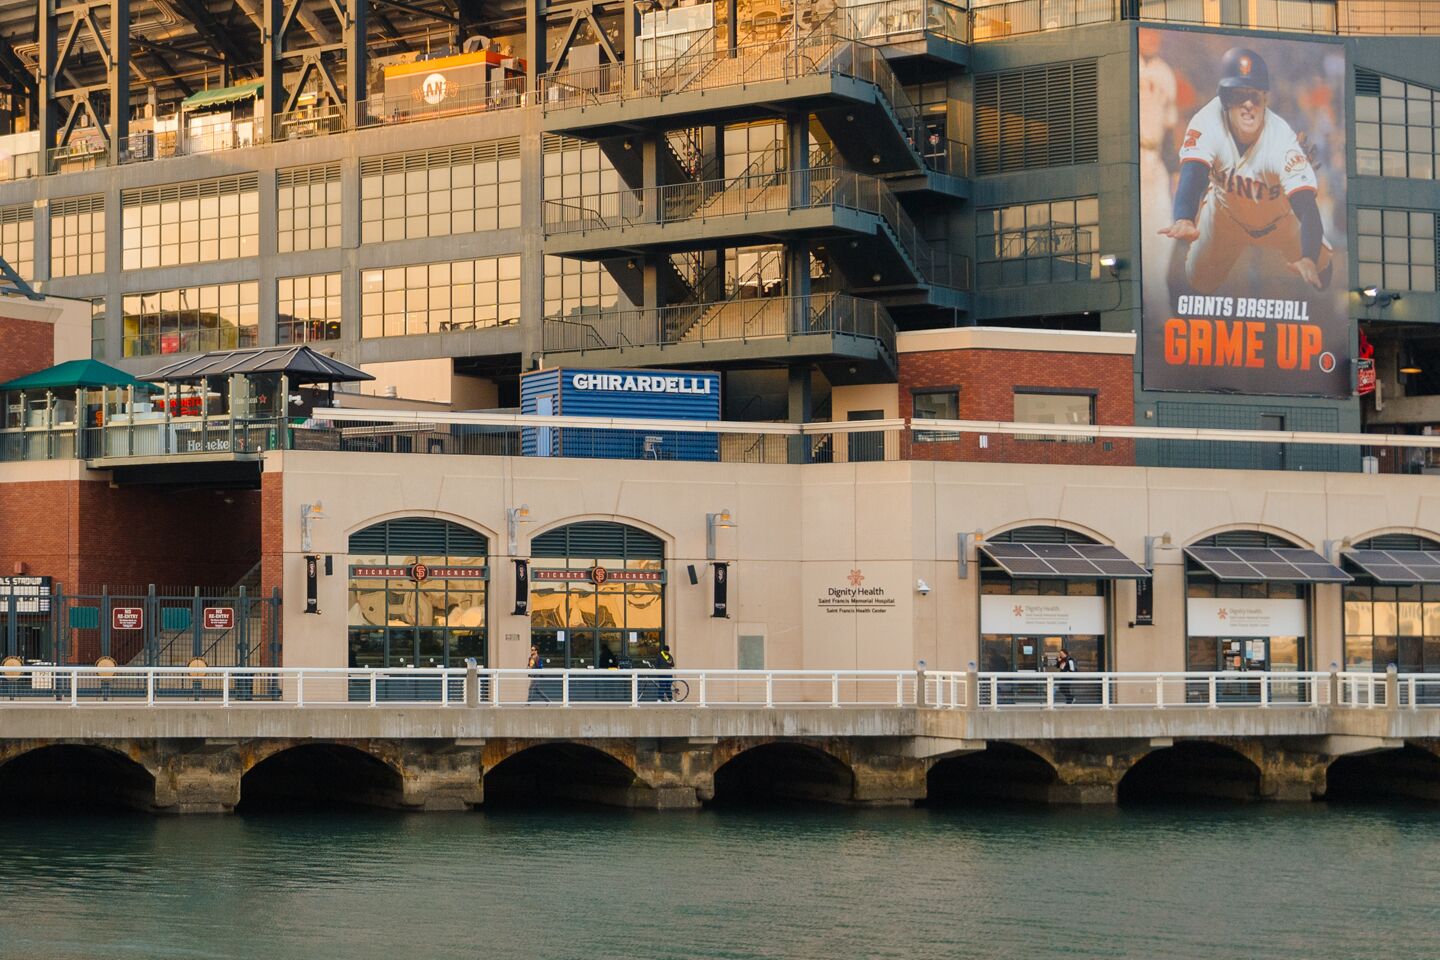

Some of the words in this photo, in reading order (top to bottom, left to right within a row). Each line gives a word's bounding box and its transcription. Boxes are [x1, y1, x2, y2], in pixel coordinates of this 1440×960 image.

[1177, 295, 1233, 317] GIANTS
[1236, 297, 1310, 321] BASEBALL
[1164, 318, 1266, 369] GAME
[572, 373, 711, 394] GHIRARDELLI
[357, 568, 404, 576] TICKETS
[828, 587, 857, 597] Dignity
[858, 587, 884, 596] Health
